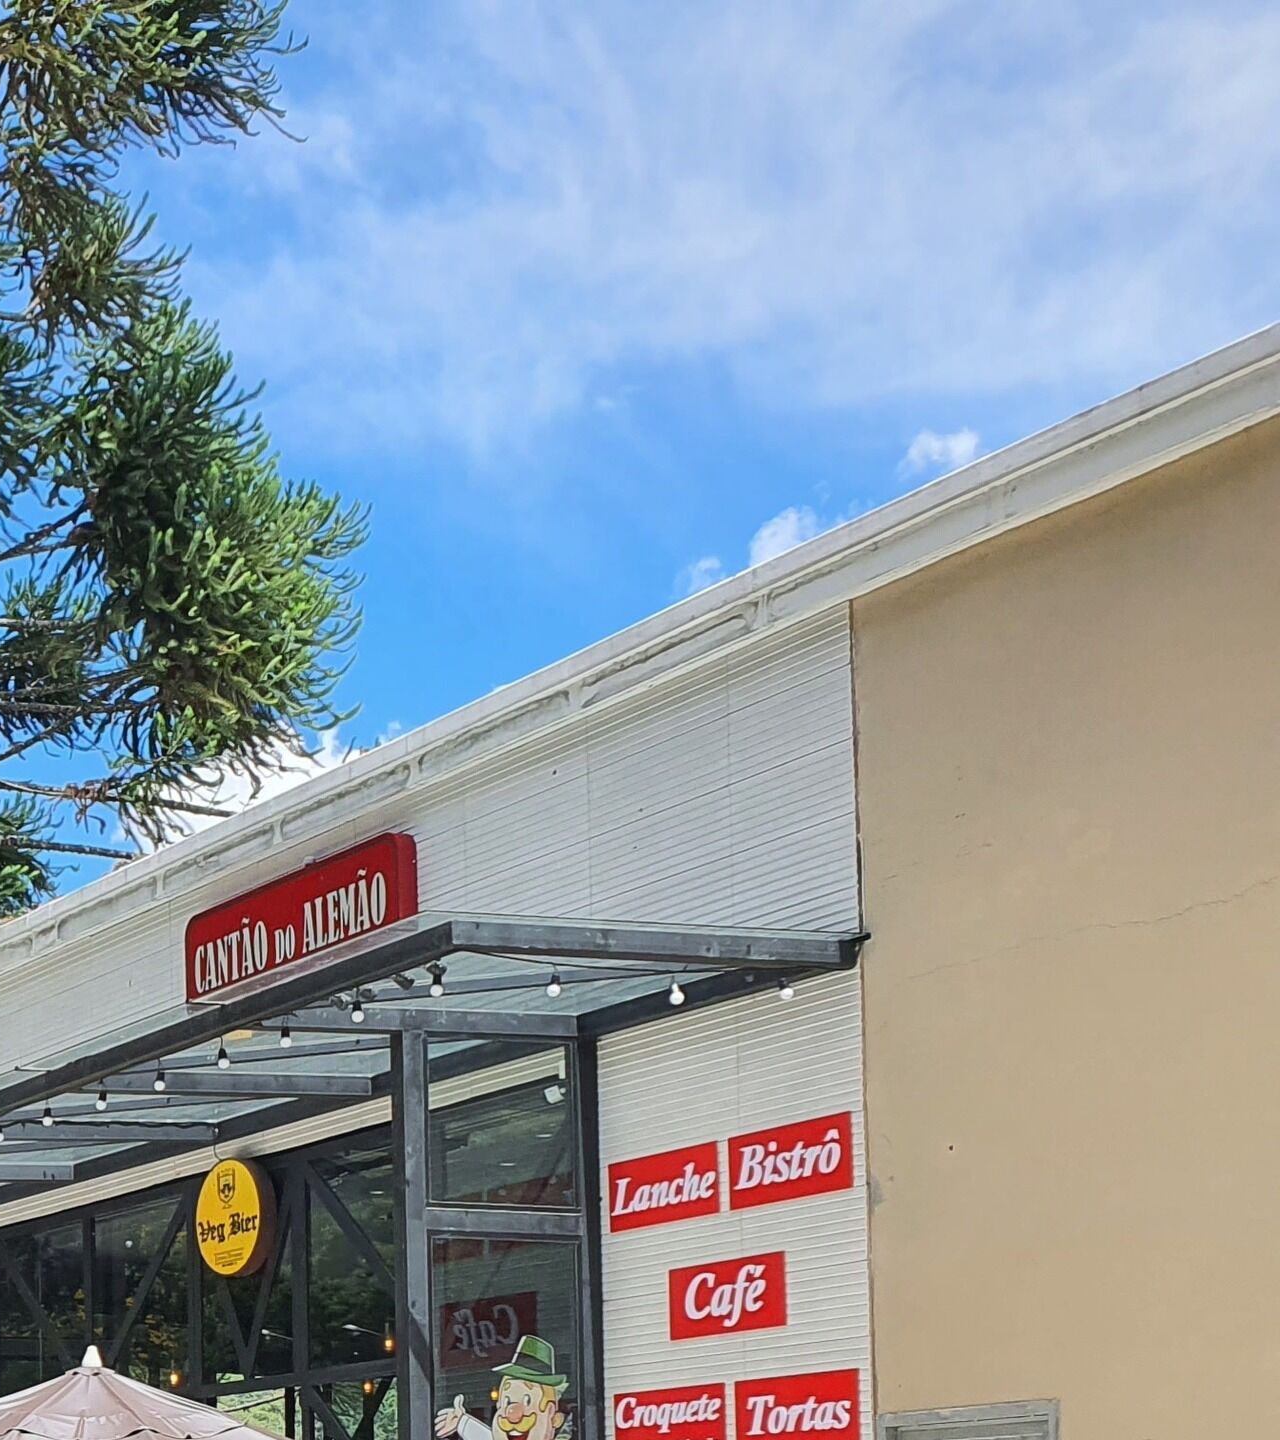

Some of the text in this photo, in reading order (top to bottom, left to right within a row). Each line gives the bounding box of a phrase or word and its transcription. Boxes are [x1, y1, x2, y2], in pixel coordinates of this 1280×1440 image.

[194, 867, 387, 993] CANTÃO DO ALEMÃO
[734, 1129, 841, 1190] Bistrô
[611, 1162, 716, 1216] Lanche
[198, 1211, 258, 1243] Veg Bier
[684, 1264, 766, 1327] Café
[616, 1394, 721, 1433] Croquete
[746, 1394, 852, 1436] Tortas
